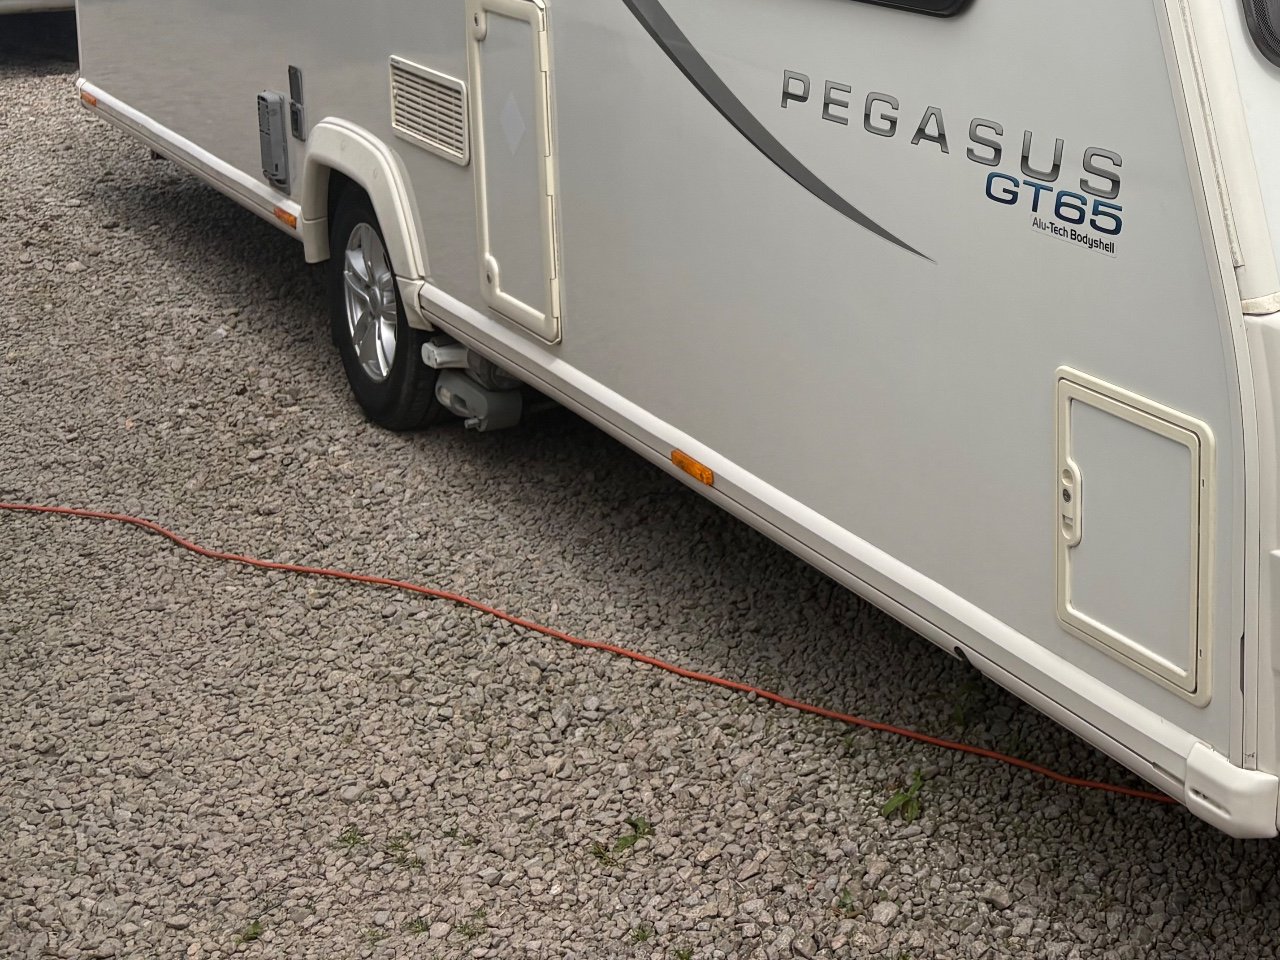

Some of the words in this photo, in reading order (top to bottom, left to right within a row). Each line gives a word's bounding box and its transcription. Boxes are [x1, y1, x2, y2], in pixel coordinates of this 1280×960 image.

[780, 69, 1123, 200] PEGASUS
[985, 171, 1123, 236] GT65
[1032, 216, 1069, 238] Alu-Tech
[1070, 228, 1115, 254] Bodyshell
